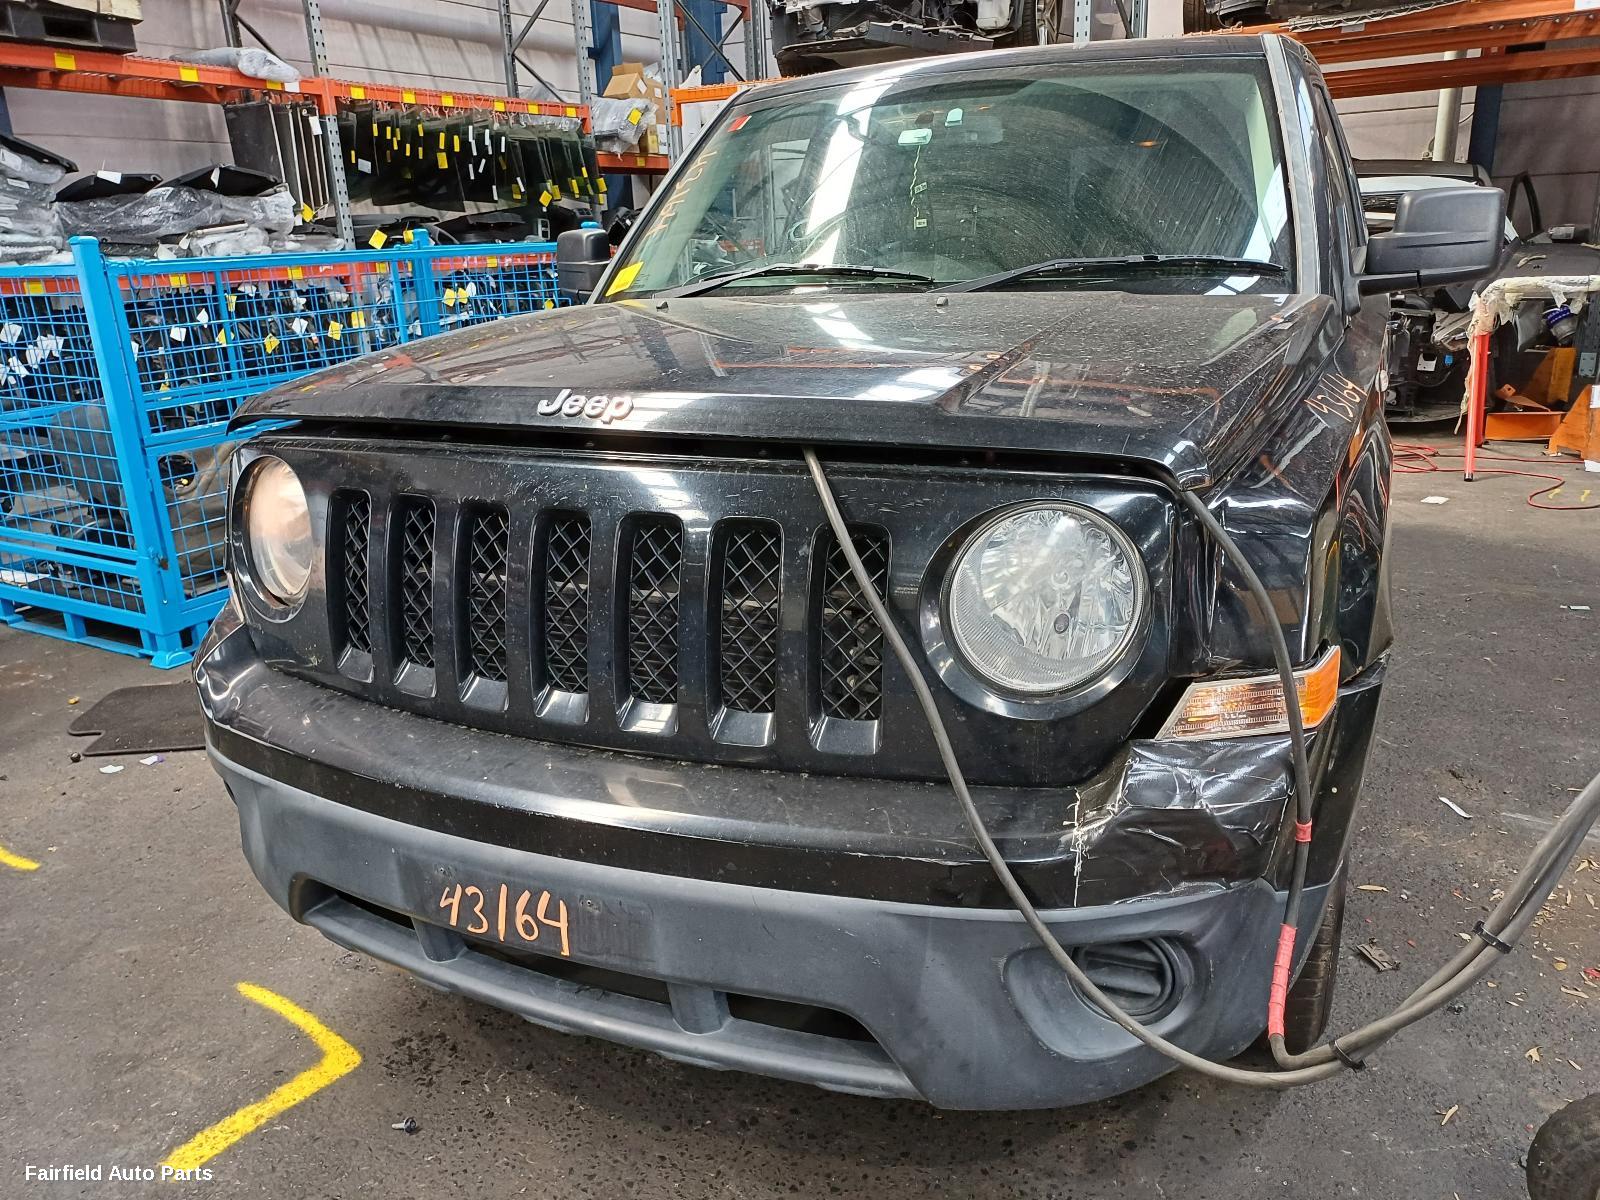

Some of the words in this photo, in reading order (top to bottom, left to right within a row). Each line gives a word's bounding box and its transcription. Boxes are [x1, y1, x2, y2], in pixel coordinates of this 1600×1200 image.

[537, 388, 634, 425] Jeep
[1303, 373, 1368, 423] 43164
[439, 883, 570, 957] 43164
